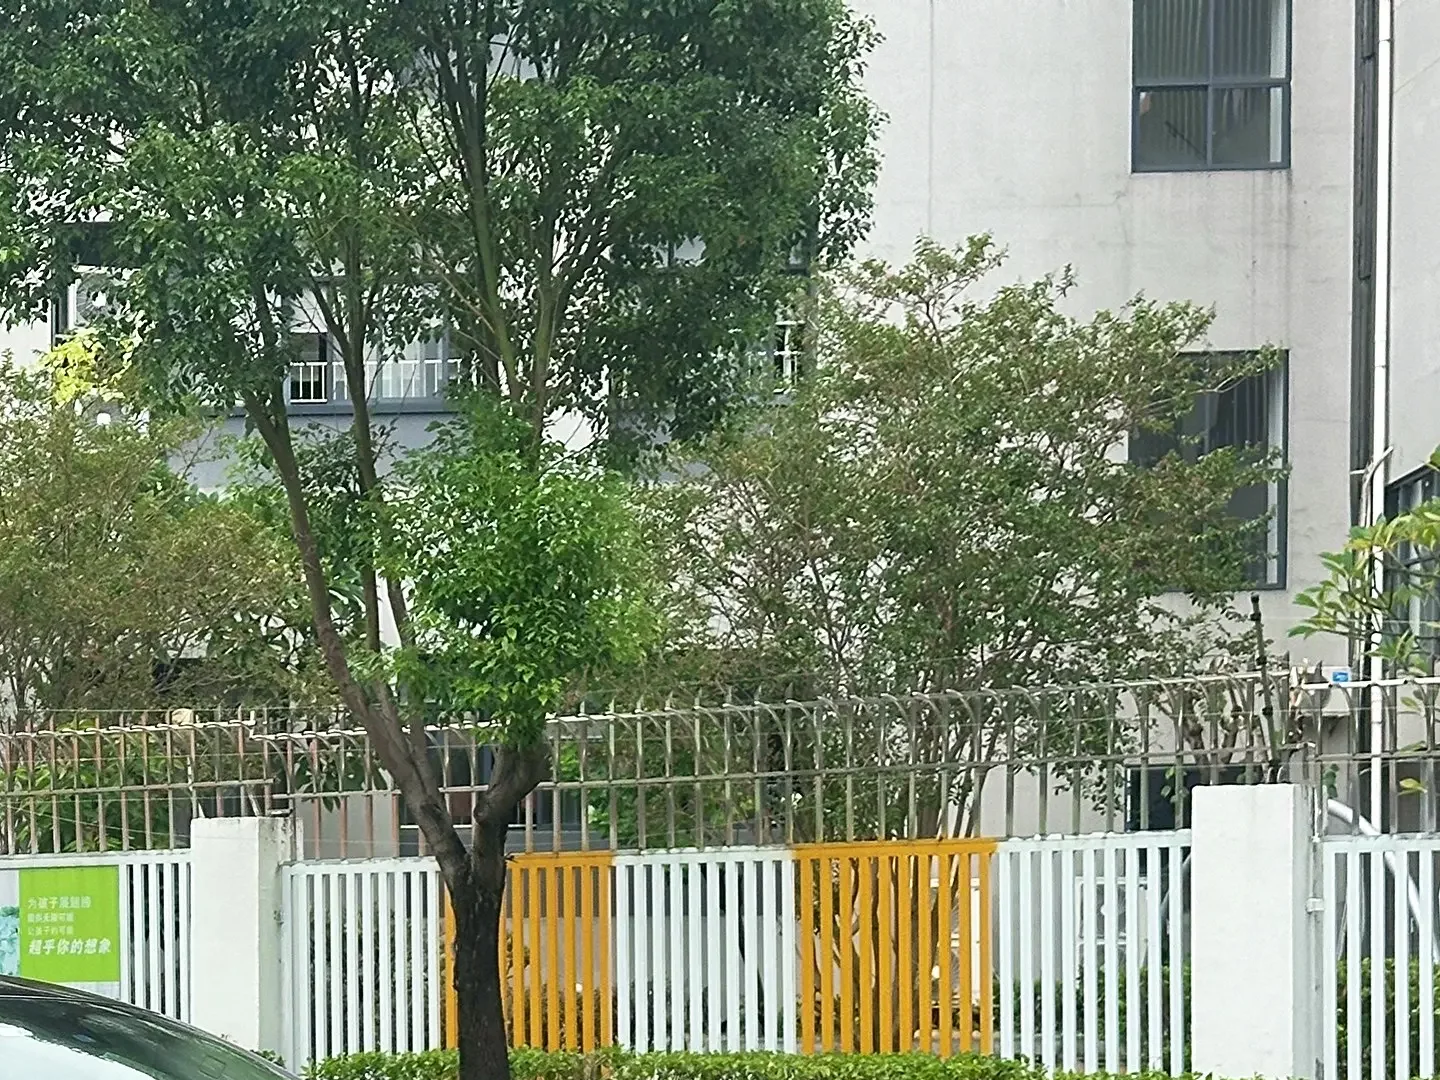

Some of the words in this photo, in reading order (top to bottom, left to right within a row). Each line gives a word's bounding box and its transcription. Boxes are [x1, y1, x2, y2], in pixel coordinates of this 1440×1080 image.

[28, 938, 112, 955] 超乎你的想象
